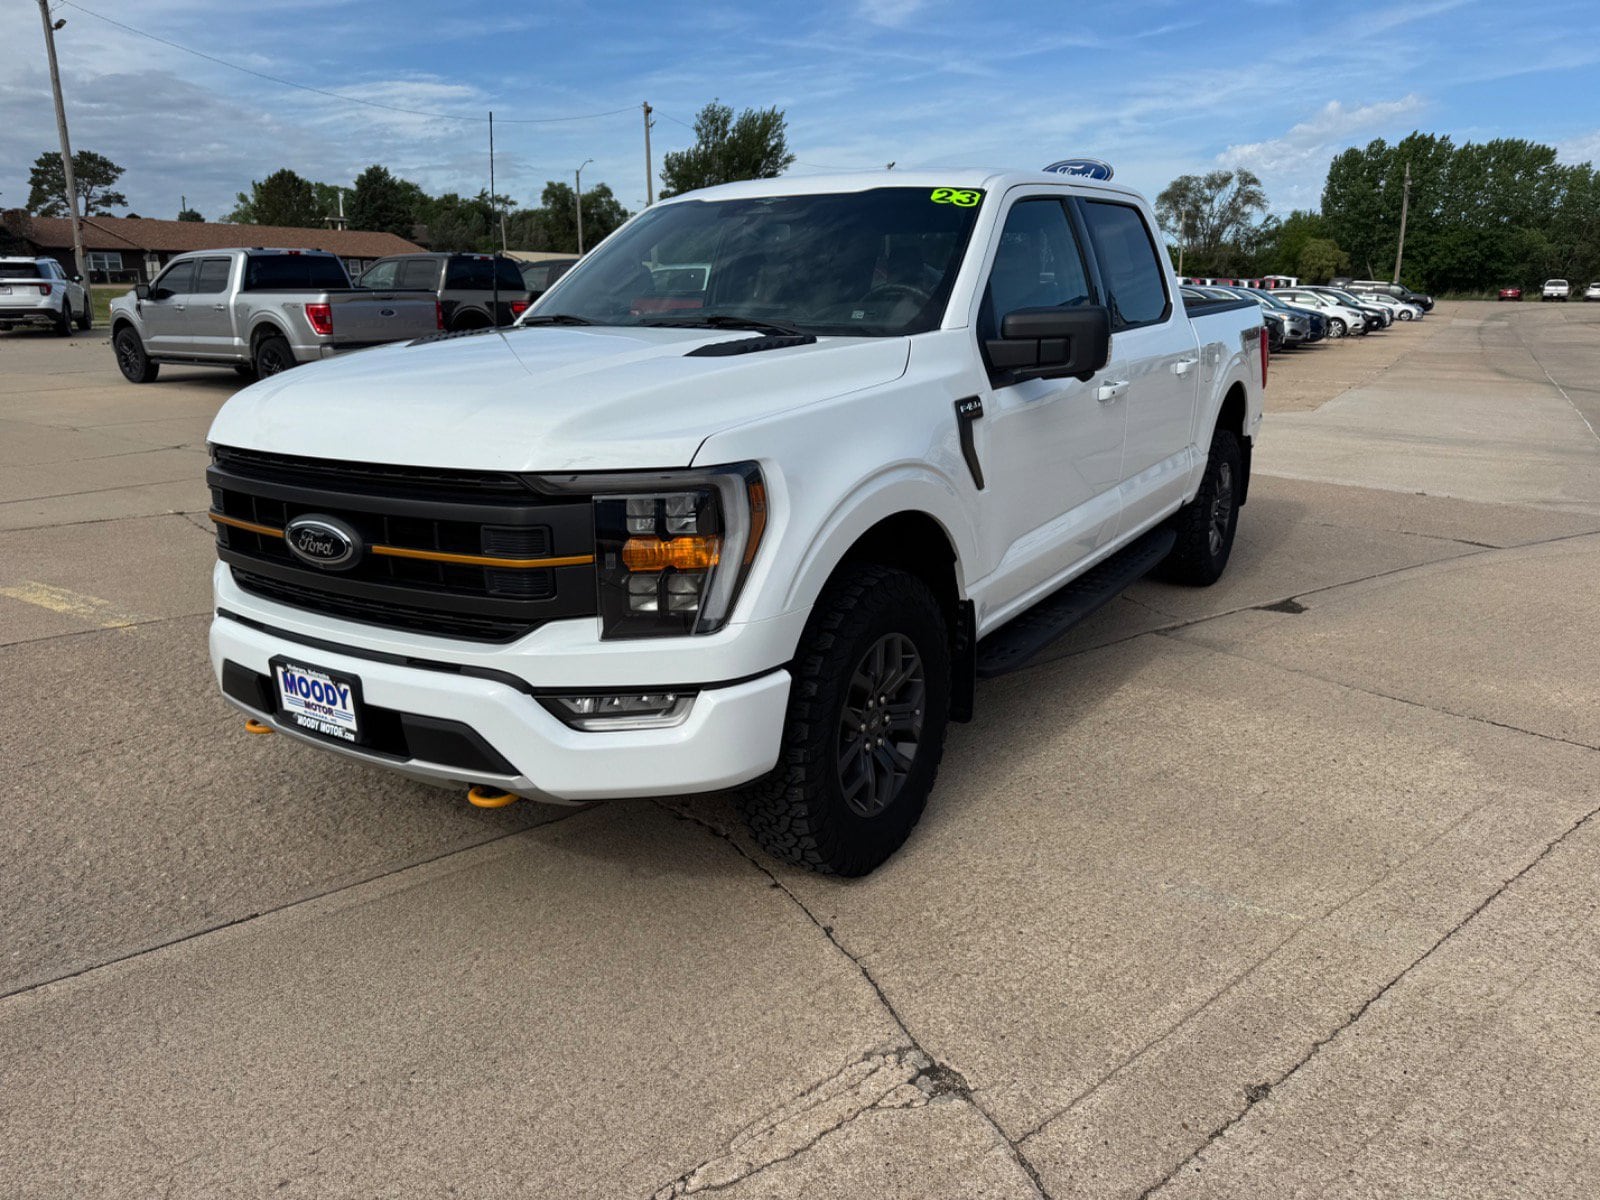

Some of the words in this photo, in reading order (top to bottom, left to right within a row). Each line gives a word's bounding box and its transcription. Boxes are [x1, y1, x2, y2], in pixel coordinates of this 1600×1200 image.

[1057, 165, 1096, 179] Fd
[933, 188, 980, 206] 23
[299, 528, 334, 556] Ford
[282, 671, 349, 710] MOODY
[304, 700, 335, 717] MOTOR
[297, 715, 320, 731] MOODY
